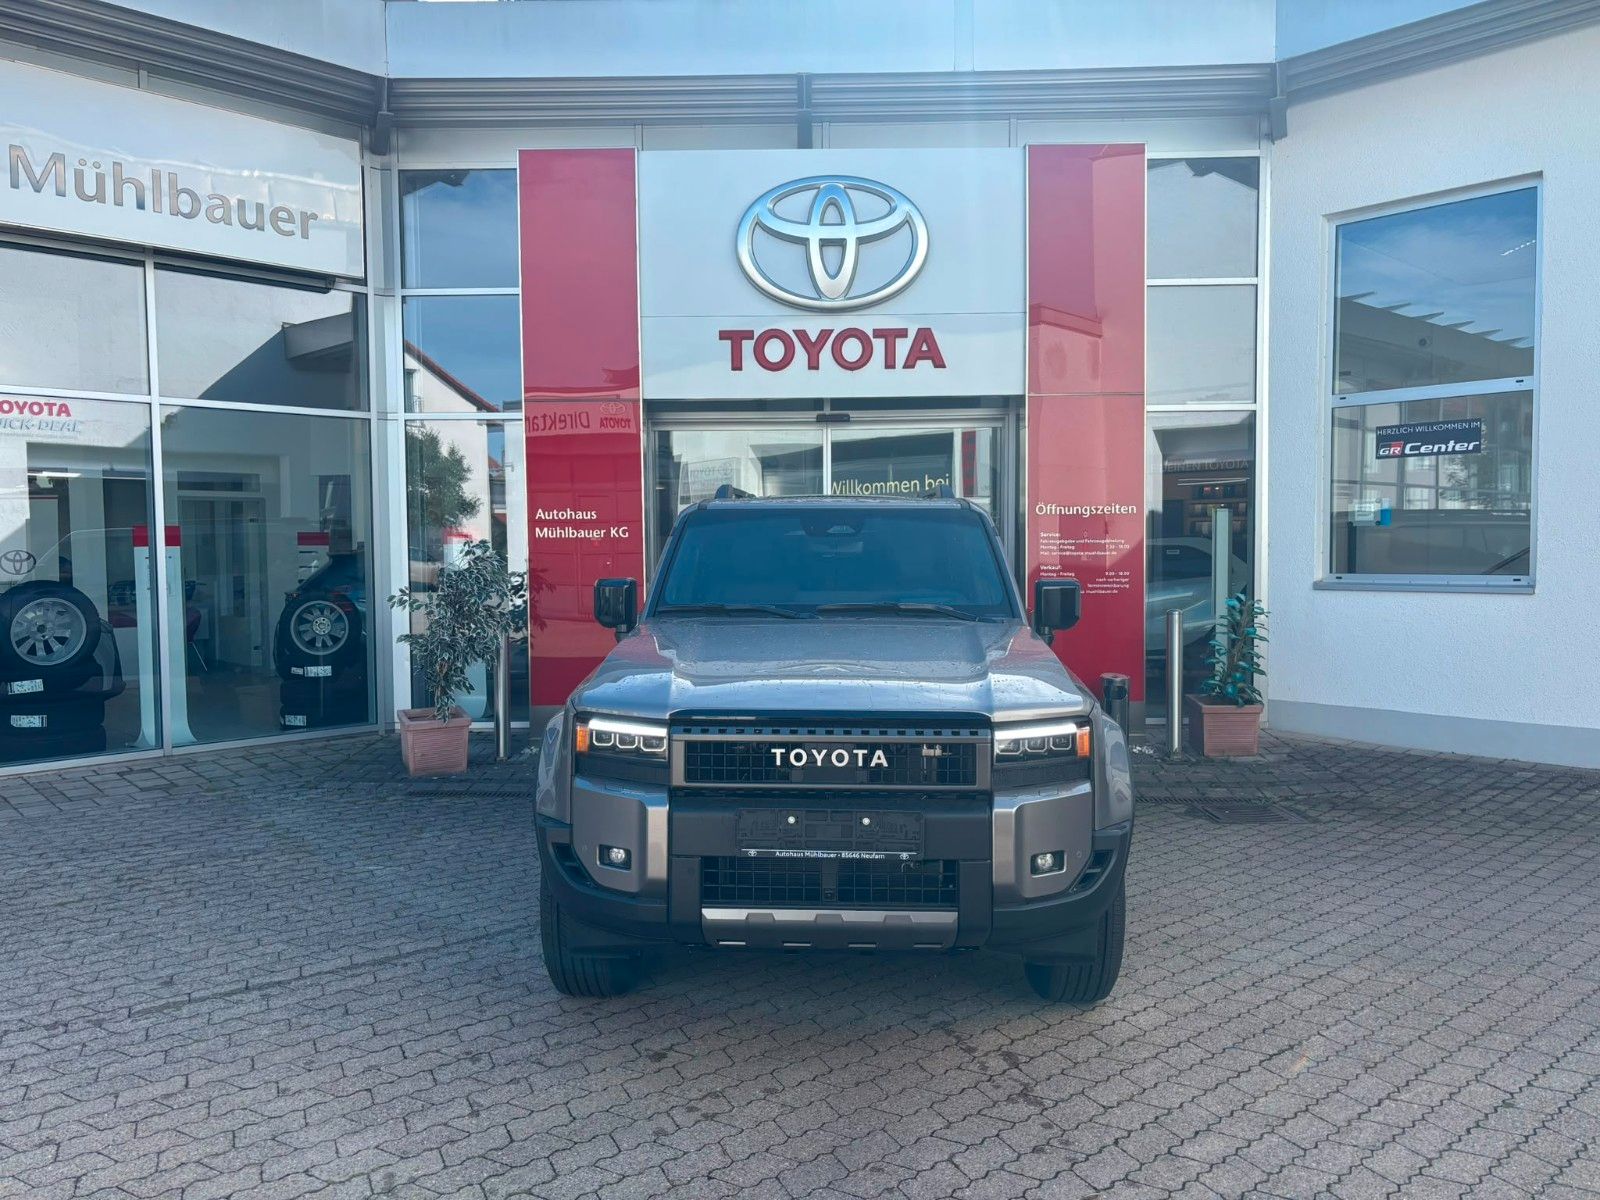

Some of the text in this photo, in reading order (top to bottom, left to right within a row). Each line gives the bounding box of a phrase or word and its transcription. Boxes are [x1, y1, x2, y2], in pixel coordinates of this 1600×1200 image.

[8, 144, 318, 240] Mühlbauer
[718, 327, 947, 372] TOYOTA
[1377, 427, 1413, 435] HERZLICH
[1415, 422, 1468, 432] WILLKOMMEN
[1379, 440, 1480, 455] GR Center
[831, 479, 920, 495] Willkommen
[535, 508, 597, 520] Autohaus
[1035, 502, 1137, 518] Öffnungszeiten
[535, 526, 629, 538] Mühlbauer KG
[771, 748, 888, 767] TOYOTA
[804, 851, 837, 859] Mühlbauer
